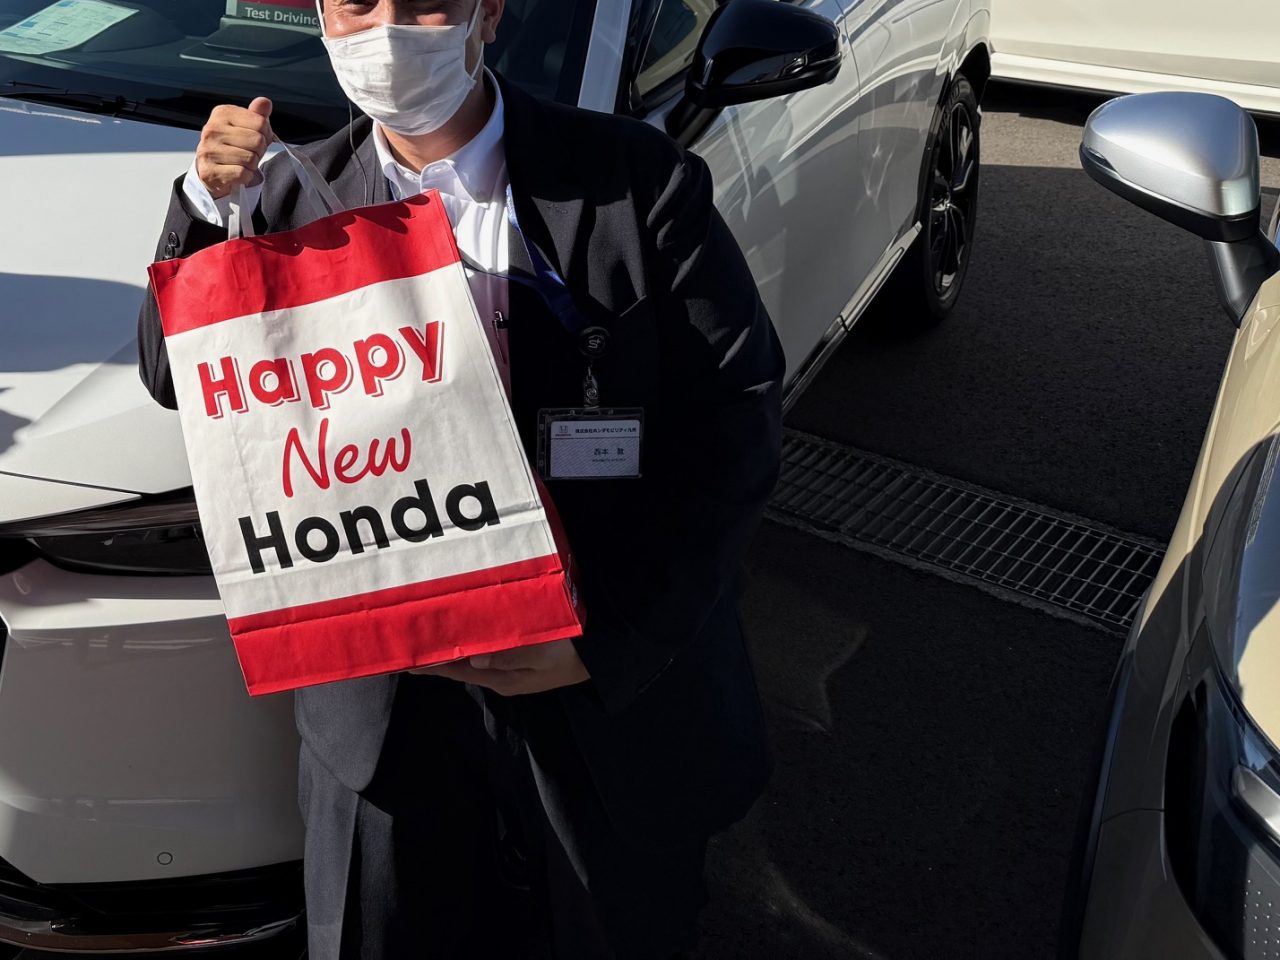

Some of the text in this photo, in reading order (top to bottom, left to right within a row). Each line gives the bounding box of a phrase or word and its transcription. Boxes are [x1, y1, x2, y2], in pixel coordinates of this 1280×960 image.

[245, 7, 270, 20] Test
[196, 320, 446, 419] Happy
[282, 417, 413, 498] New
[238, 478, 502, 574] Honda
